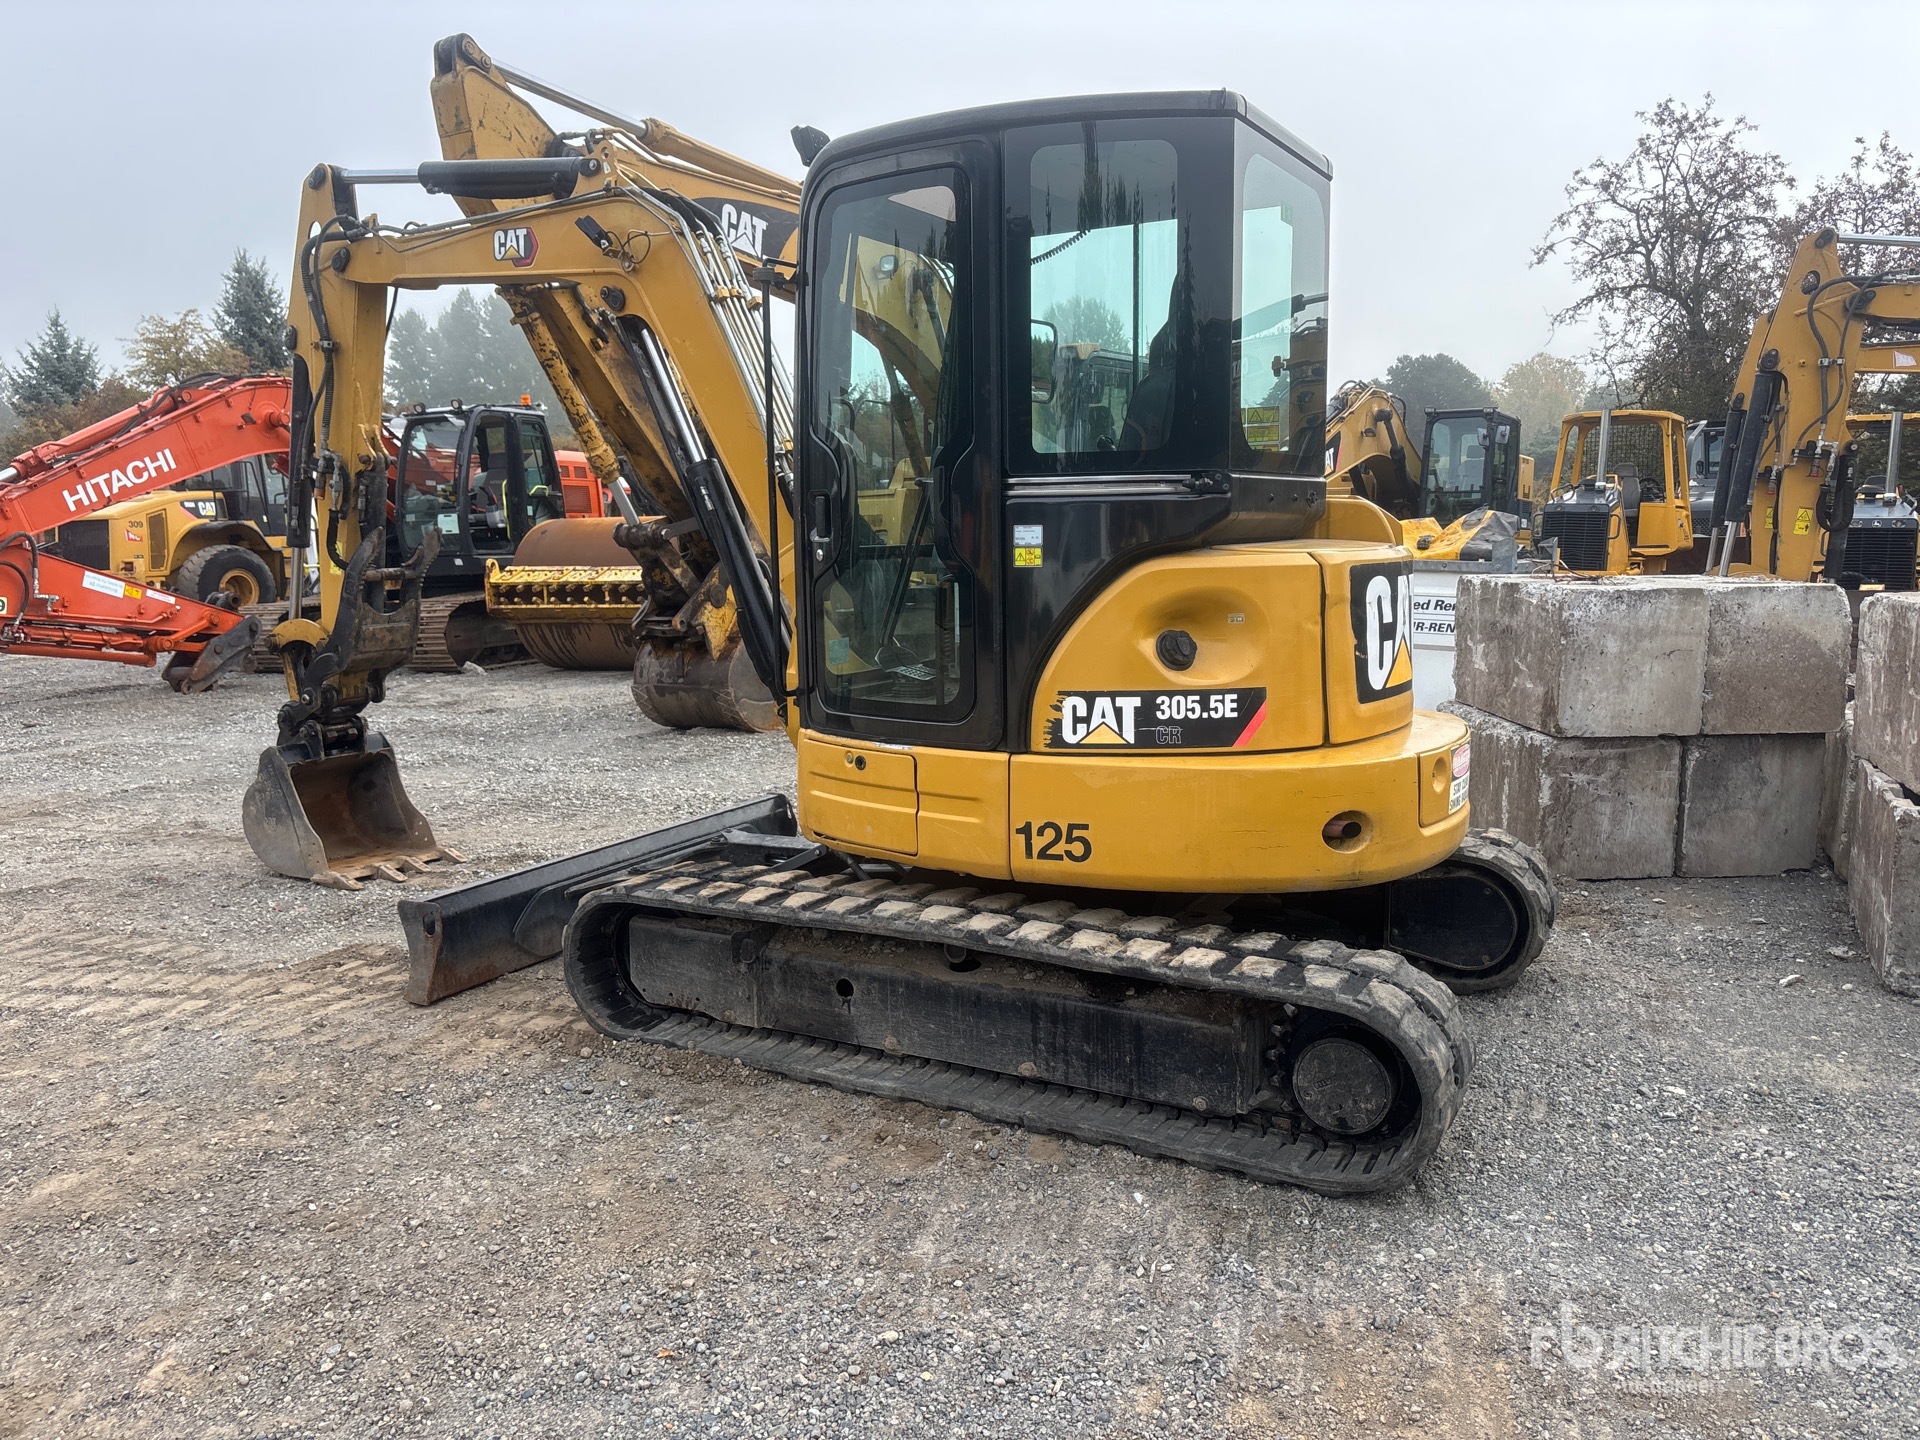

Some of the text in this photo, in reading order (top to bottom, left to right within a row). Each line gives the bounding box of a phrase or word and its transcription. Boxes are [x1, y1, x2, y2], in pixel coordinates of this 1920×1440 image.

[494, 228, 527, 259] CAT
[721, 203, 768, 257] CAT
[62, 448, 177, 512] HITACHI
[128, 520, 144, 529] 309
[1366, 574, 1414, 691] CA
[1061, 693, 1239, 744] CAT 305.5E
[1155, 725, 1182, 744] CR
[1015, 821, 1092, 863] 125
